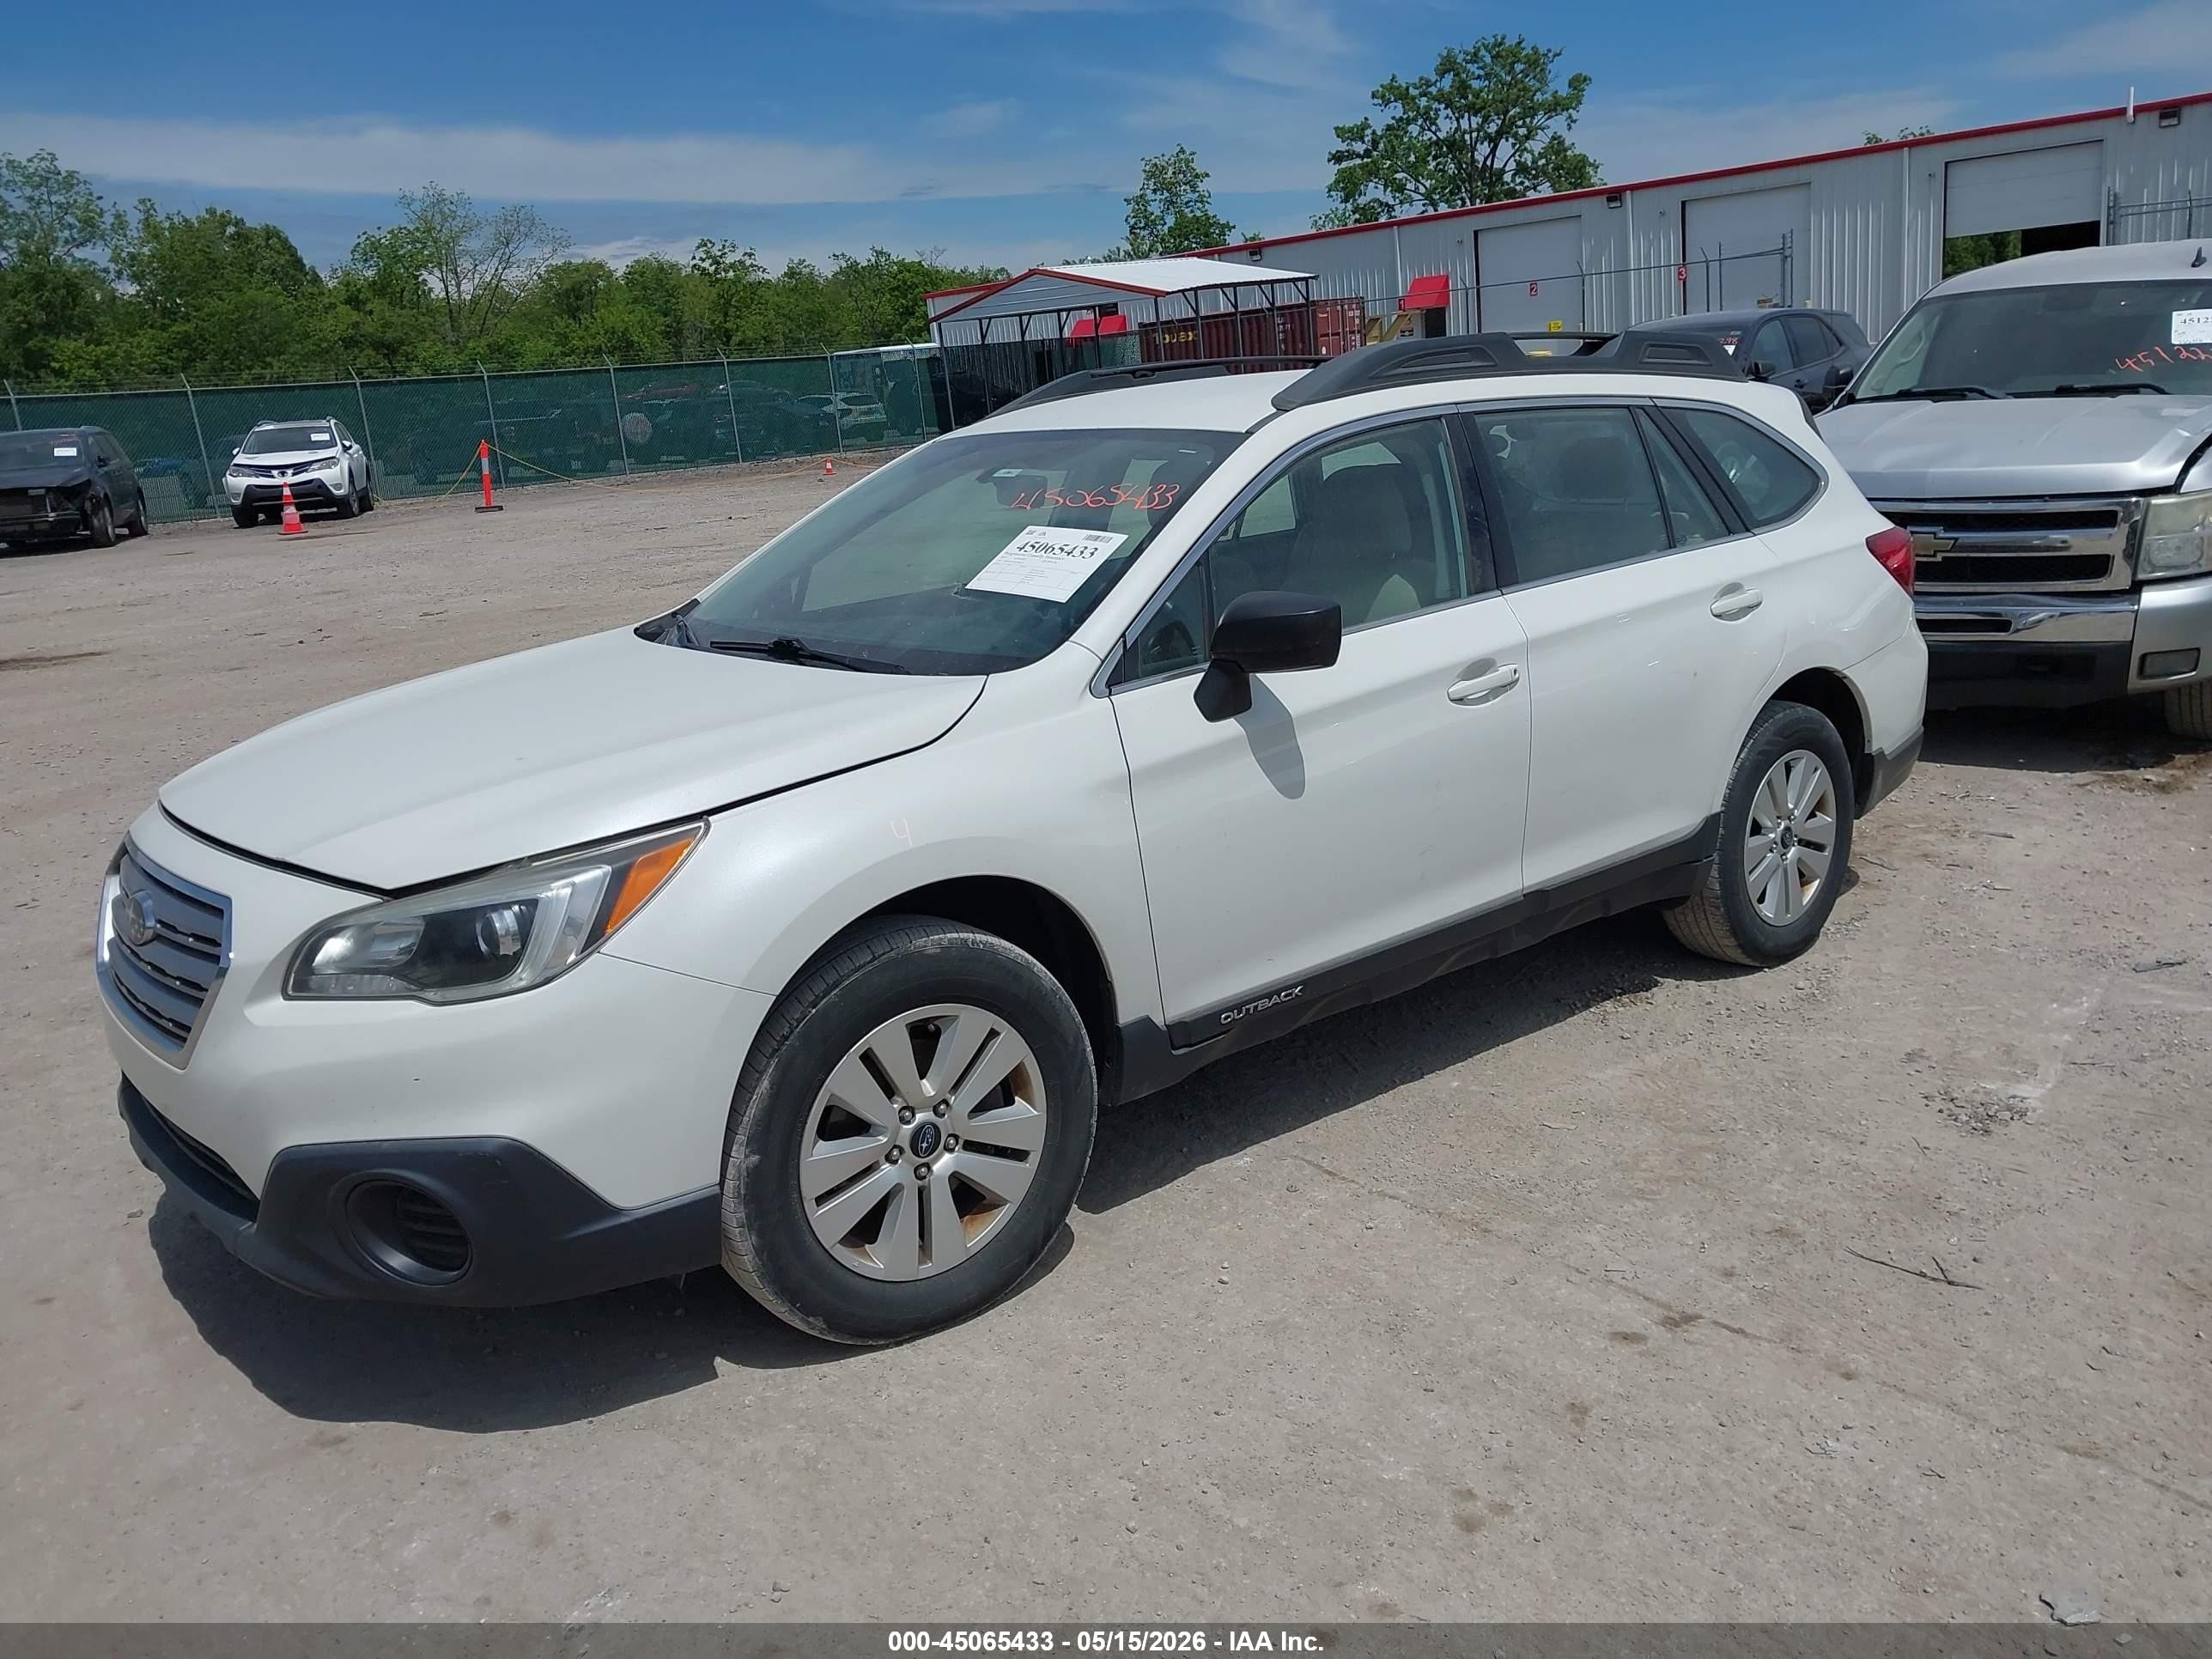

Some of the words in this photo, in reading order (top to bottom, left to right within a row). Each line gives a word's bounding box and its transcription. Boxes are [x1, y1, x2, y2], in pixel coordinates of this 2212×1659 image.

[1678, 267, 1686, 280] 3
[1529, 283, 1538, 296] 2
[2115, 345, 2212, 372] 45122
[1011, 483, 1180, 510] 45065433
[1016, 540, 1100, 559] 45065433
[1220, 985, 1304, 1024] OUTBACK
